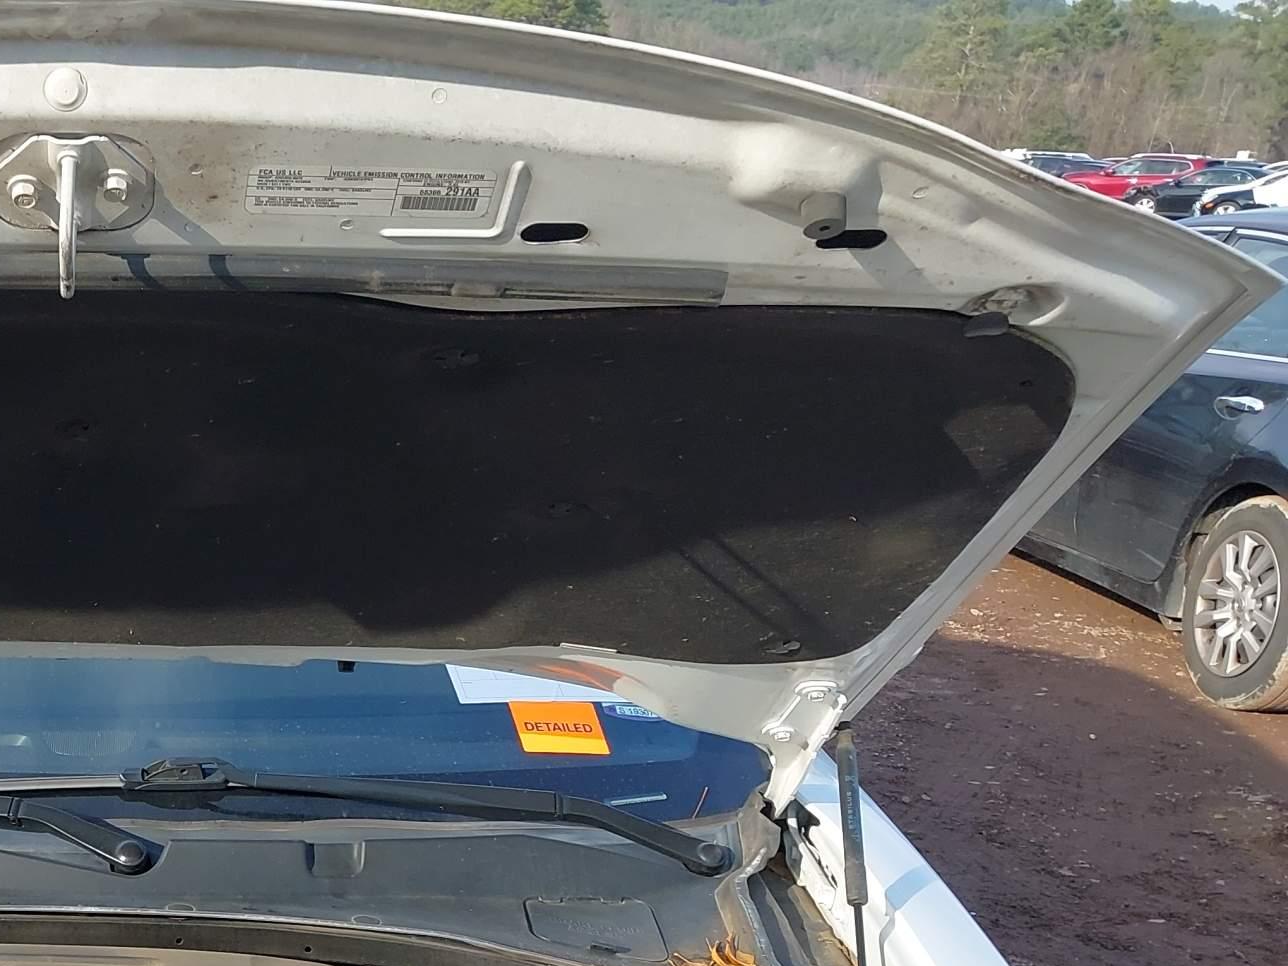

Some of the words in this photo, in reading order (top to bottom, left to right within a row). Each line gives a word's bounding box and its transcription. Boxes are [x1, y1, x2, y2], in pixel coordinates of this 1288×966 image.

[364, 171, 399, 179] EMISSION
[445, 187, 480, 197] 291AA
[524, 721, 593, 733] DETAILED
